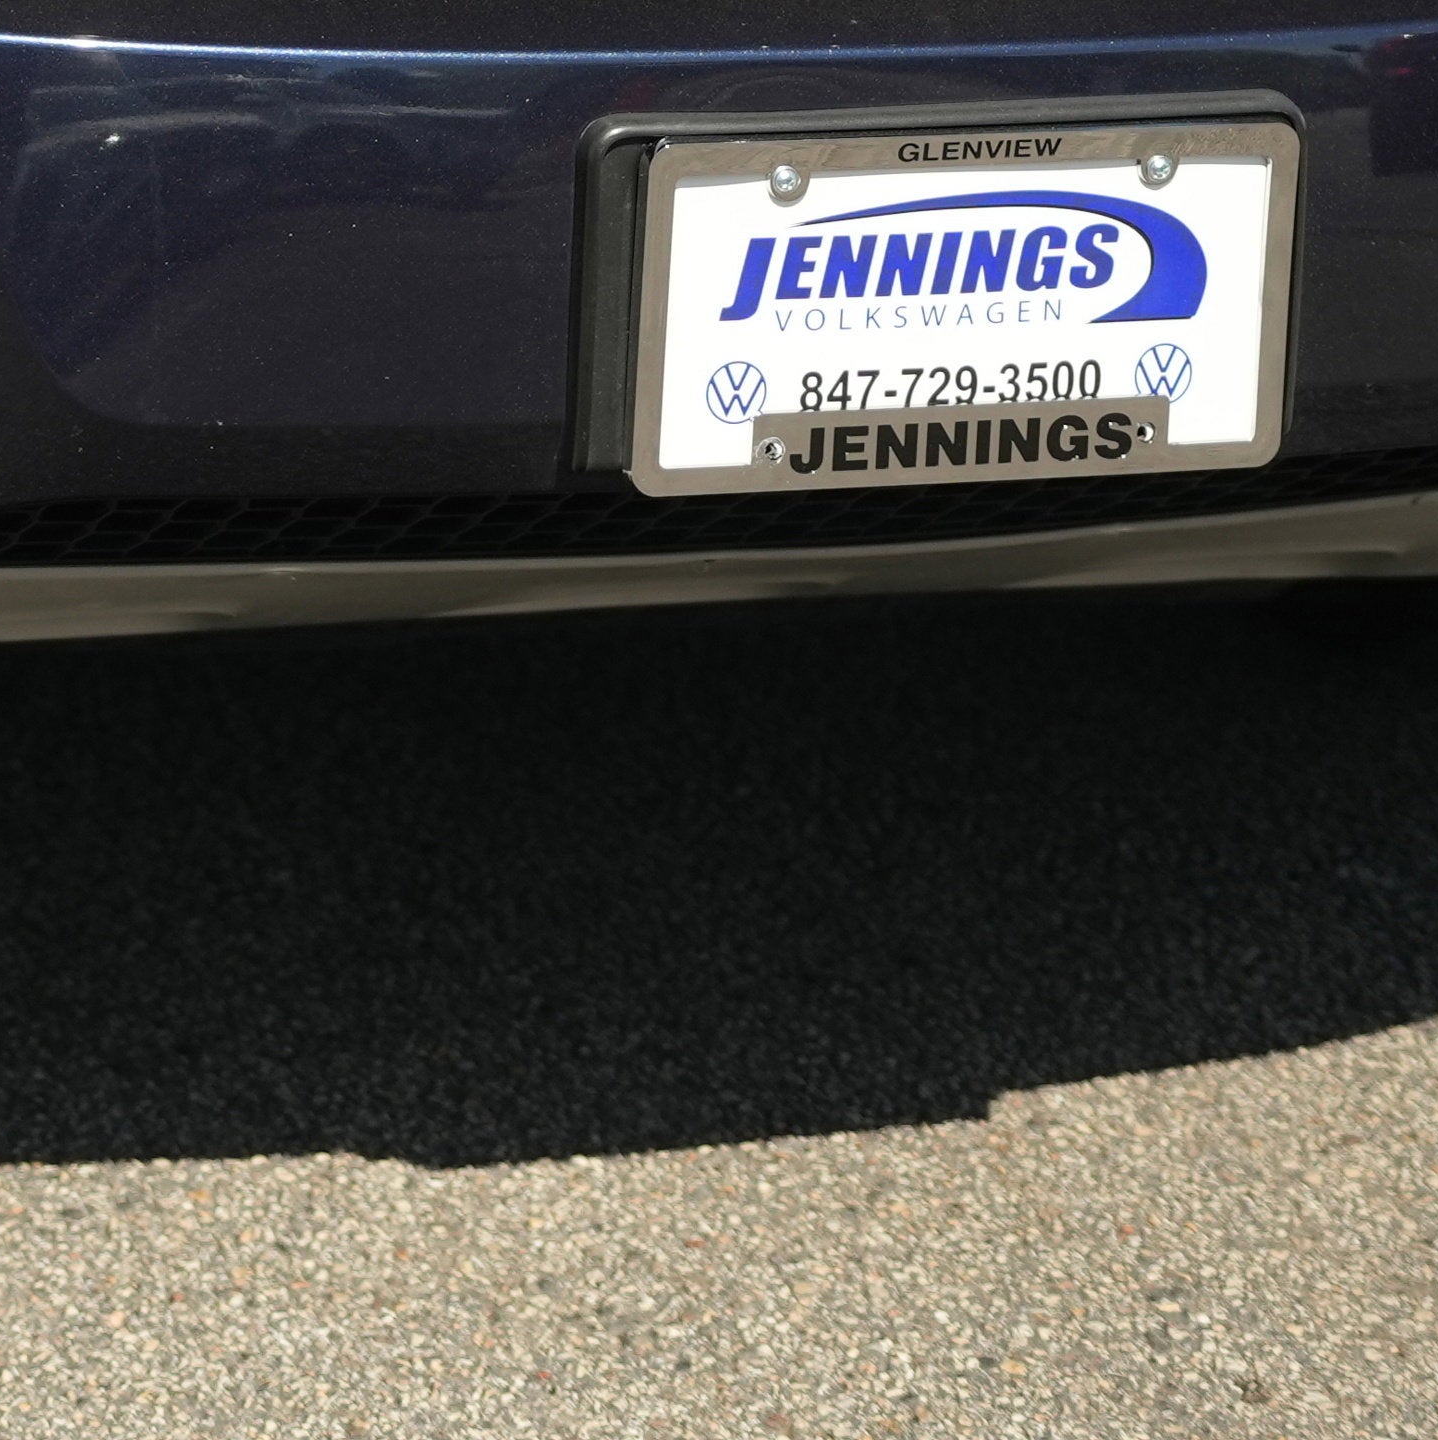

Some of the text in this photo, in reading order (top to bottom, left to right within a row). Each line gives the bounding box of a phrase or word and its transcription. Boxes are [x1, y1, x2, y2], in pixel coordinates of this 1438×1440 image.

[897, 137, 1063, 163] GLENVIEW
[719, 223, 1120, 322] JENNINGS
[775, 299, 1063, 332] VOLKSWAGEN
[799, 359, 1102, 413] 847-729-3500
[789, 413, 1134, 475] JENNINGS
